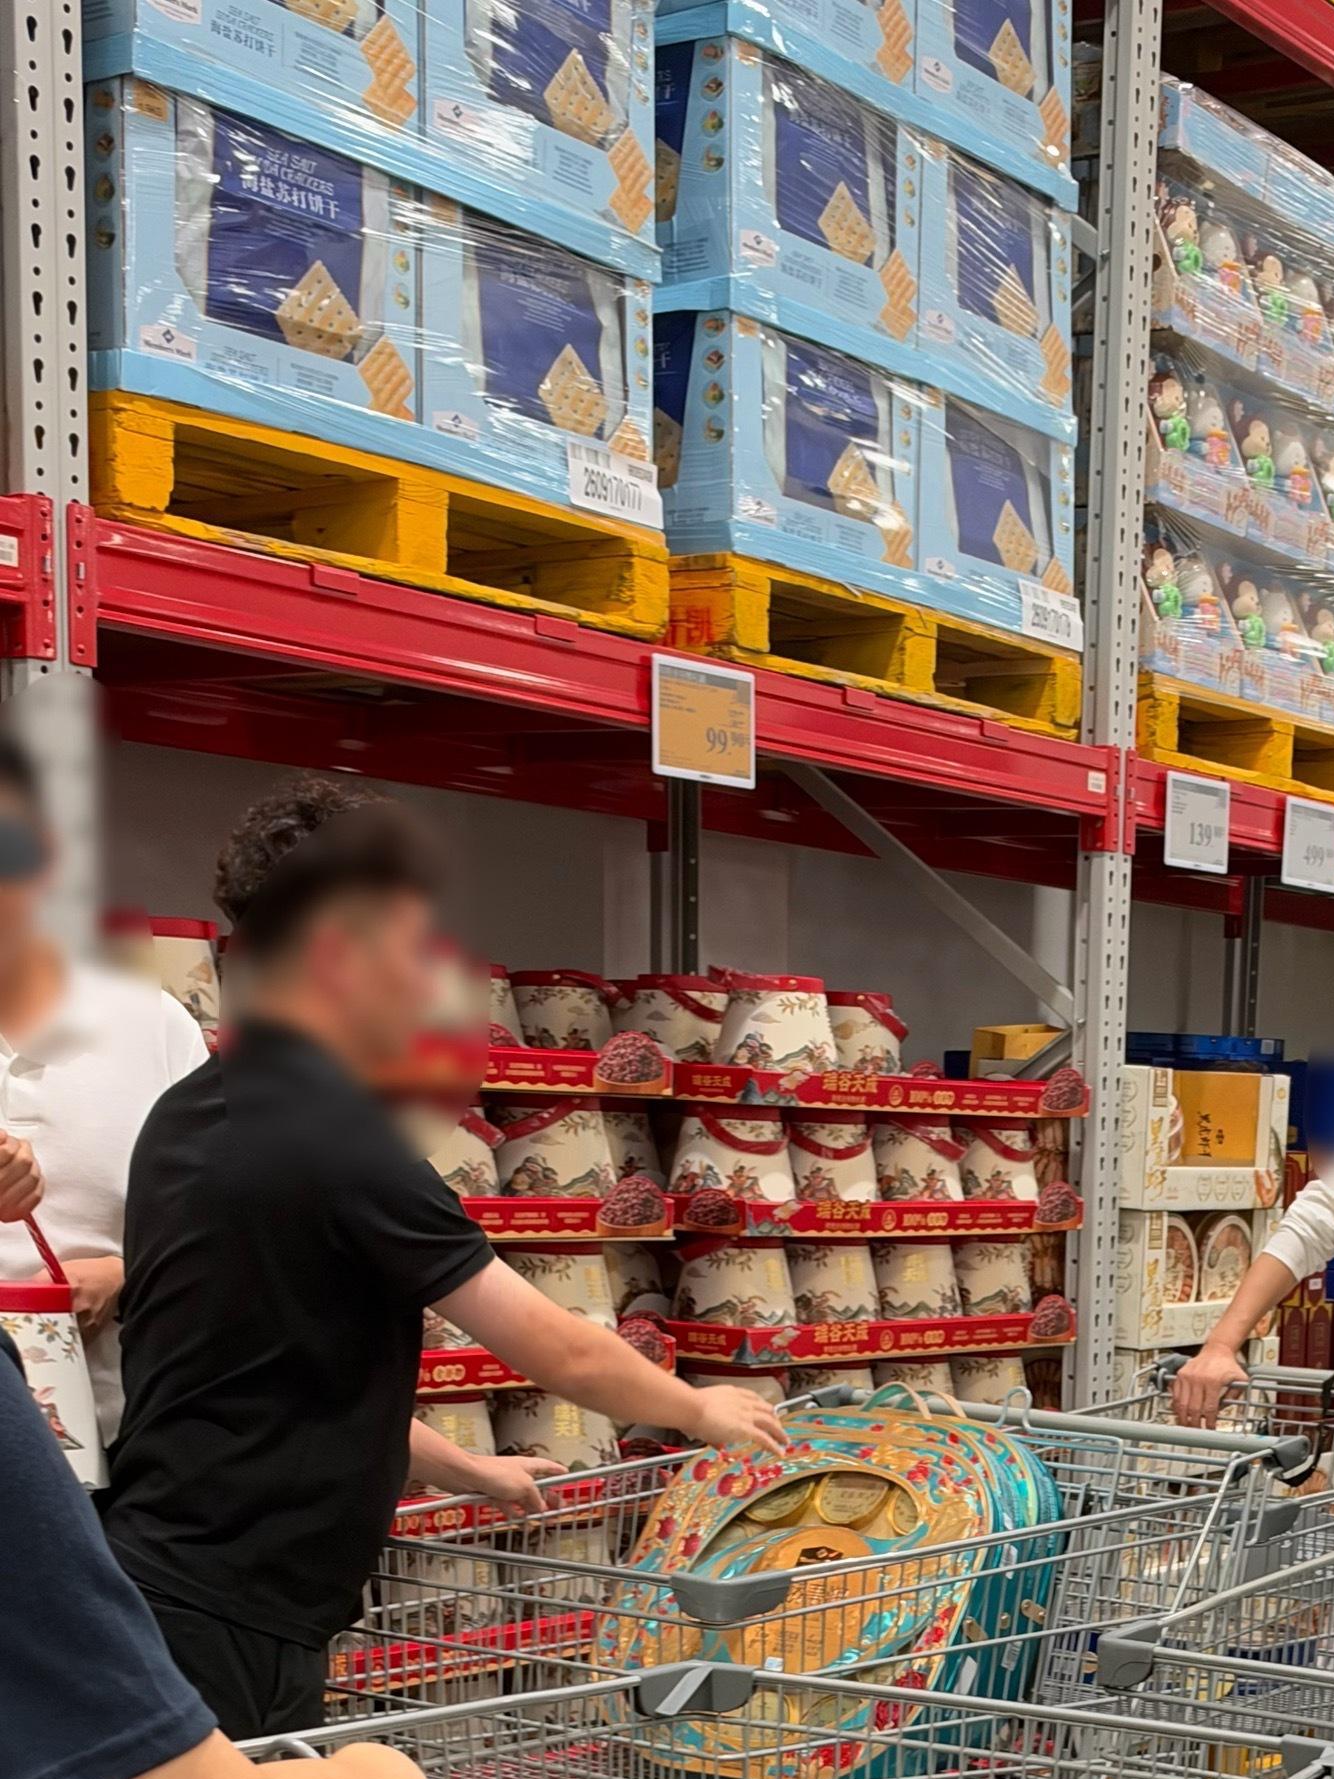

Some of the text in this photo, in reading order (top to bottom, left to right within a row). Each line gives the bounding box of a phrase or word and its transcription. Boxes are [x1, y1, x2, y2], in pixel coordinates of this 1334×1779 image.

[241, 174, 341, 220] 海盐苏打饼干
[1189, 822, 1213, 846] 139
